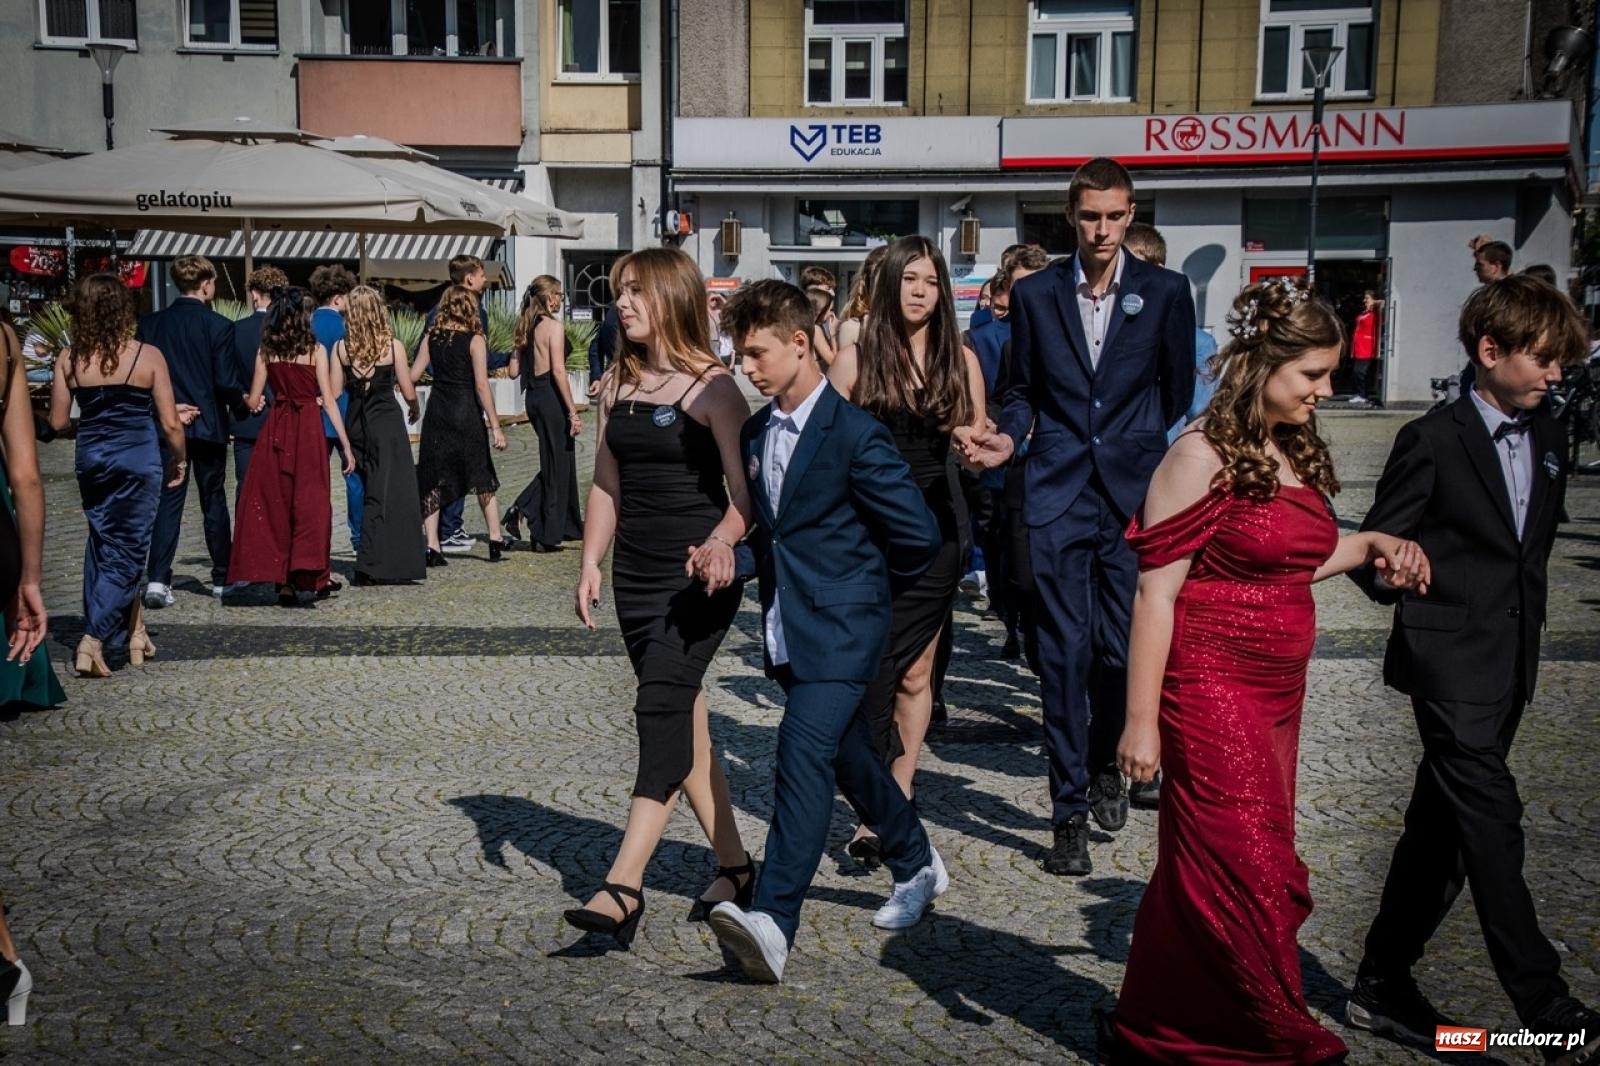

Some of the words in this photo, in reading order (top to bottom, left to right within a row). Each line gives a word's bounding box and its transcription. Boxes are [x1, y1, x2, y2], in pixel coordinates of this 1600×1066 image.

[831, 124, 882, 144] TEB
[1144, 111, 1405, 151] ROSSMANN
[830, 148, 882, 156] EDUKACJA
[136, 189, 233, 212] gelatopiu
